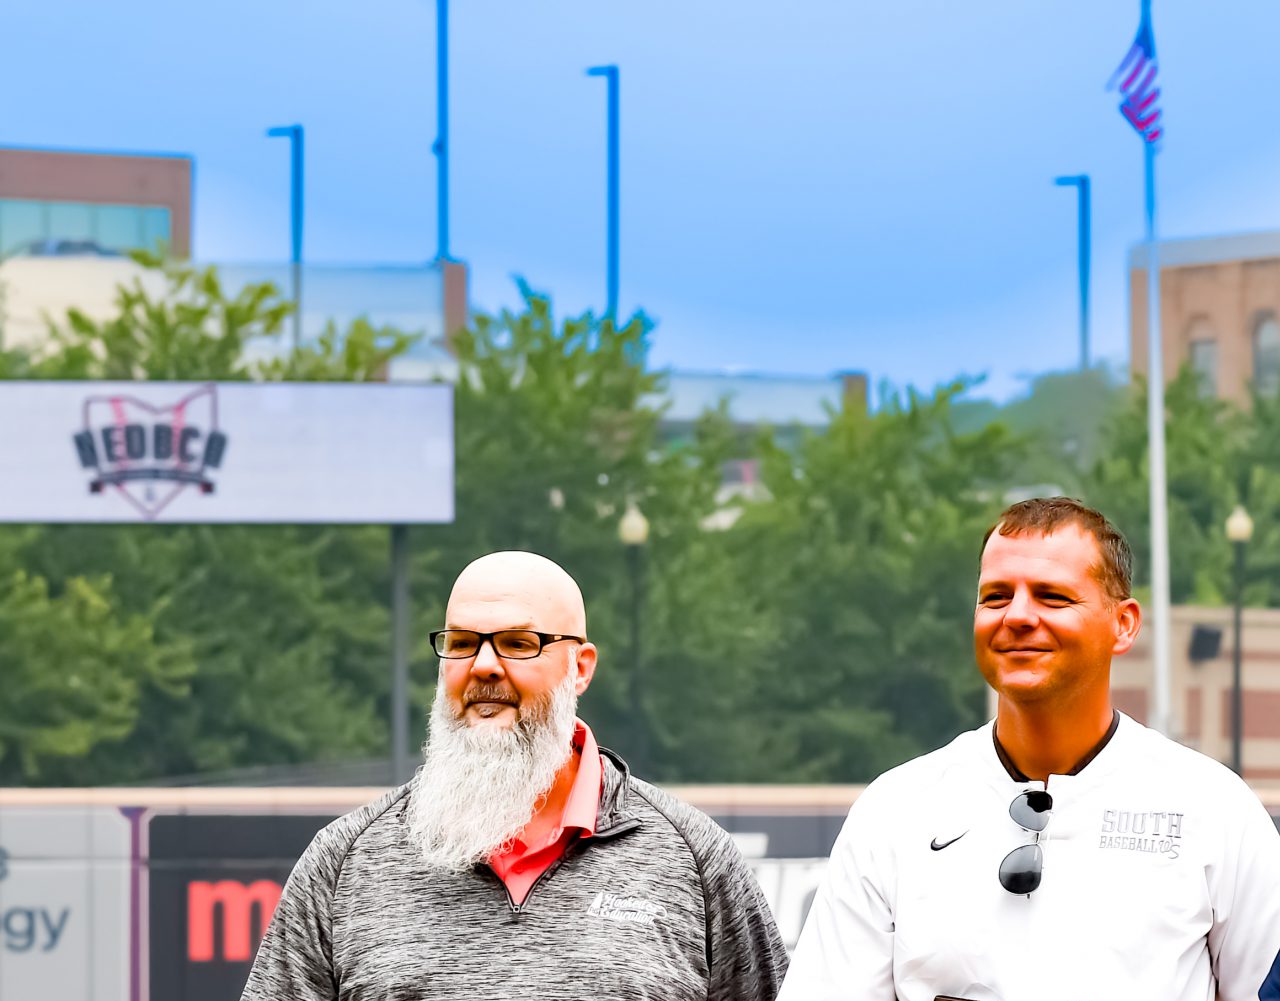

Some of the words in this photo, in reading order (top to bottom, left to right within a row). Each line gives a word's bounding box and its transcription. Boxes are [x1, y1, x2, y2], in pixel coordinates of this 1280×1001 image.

[1101, 808, 1184, 838] SOUTH
[1099, 836, 1158, 853] BASEBALL
[0, 906, 72, 953] gy
